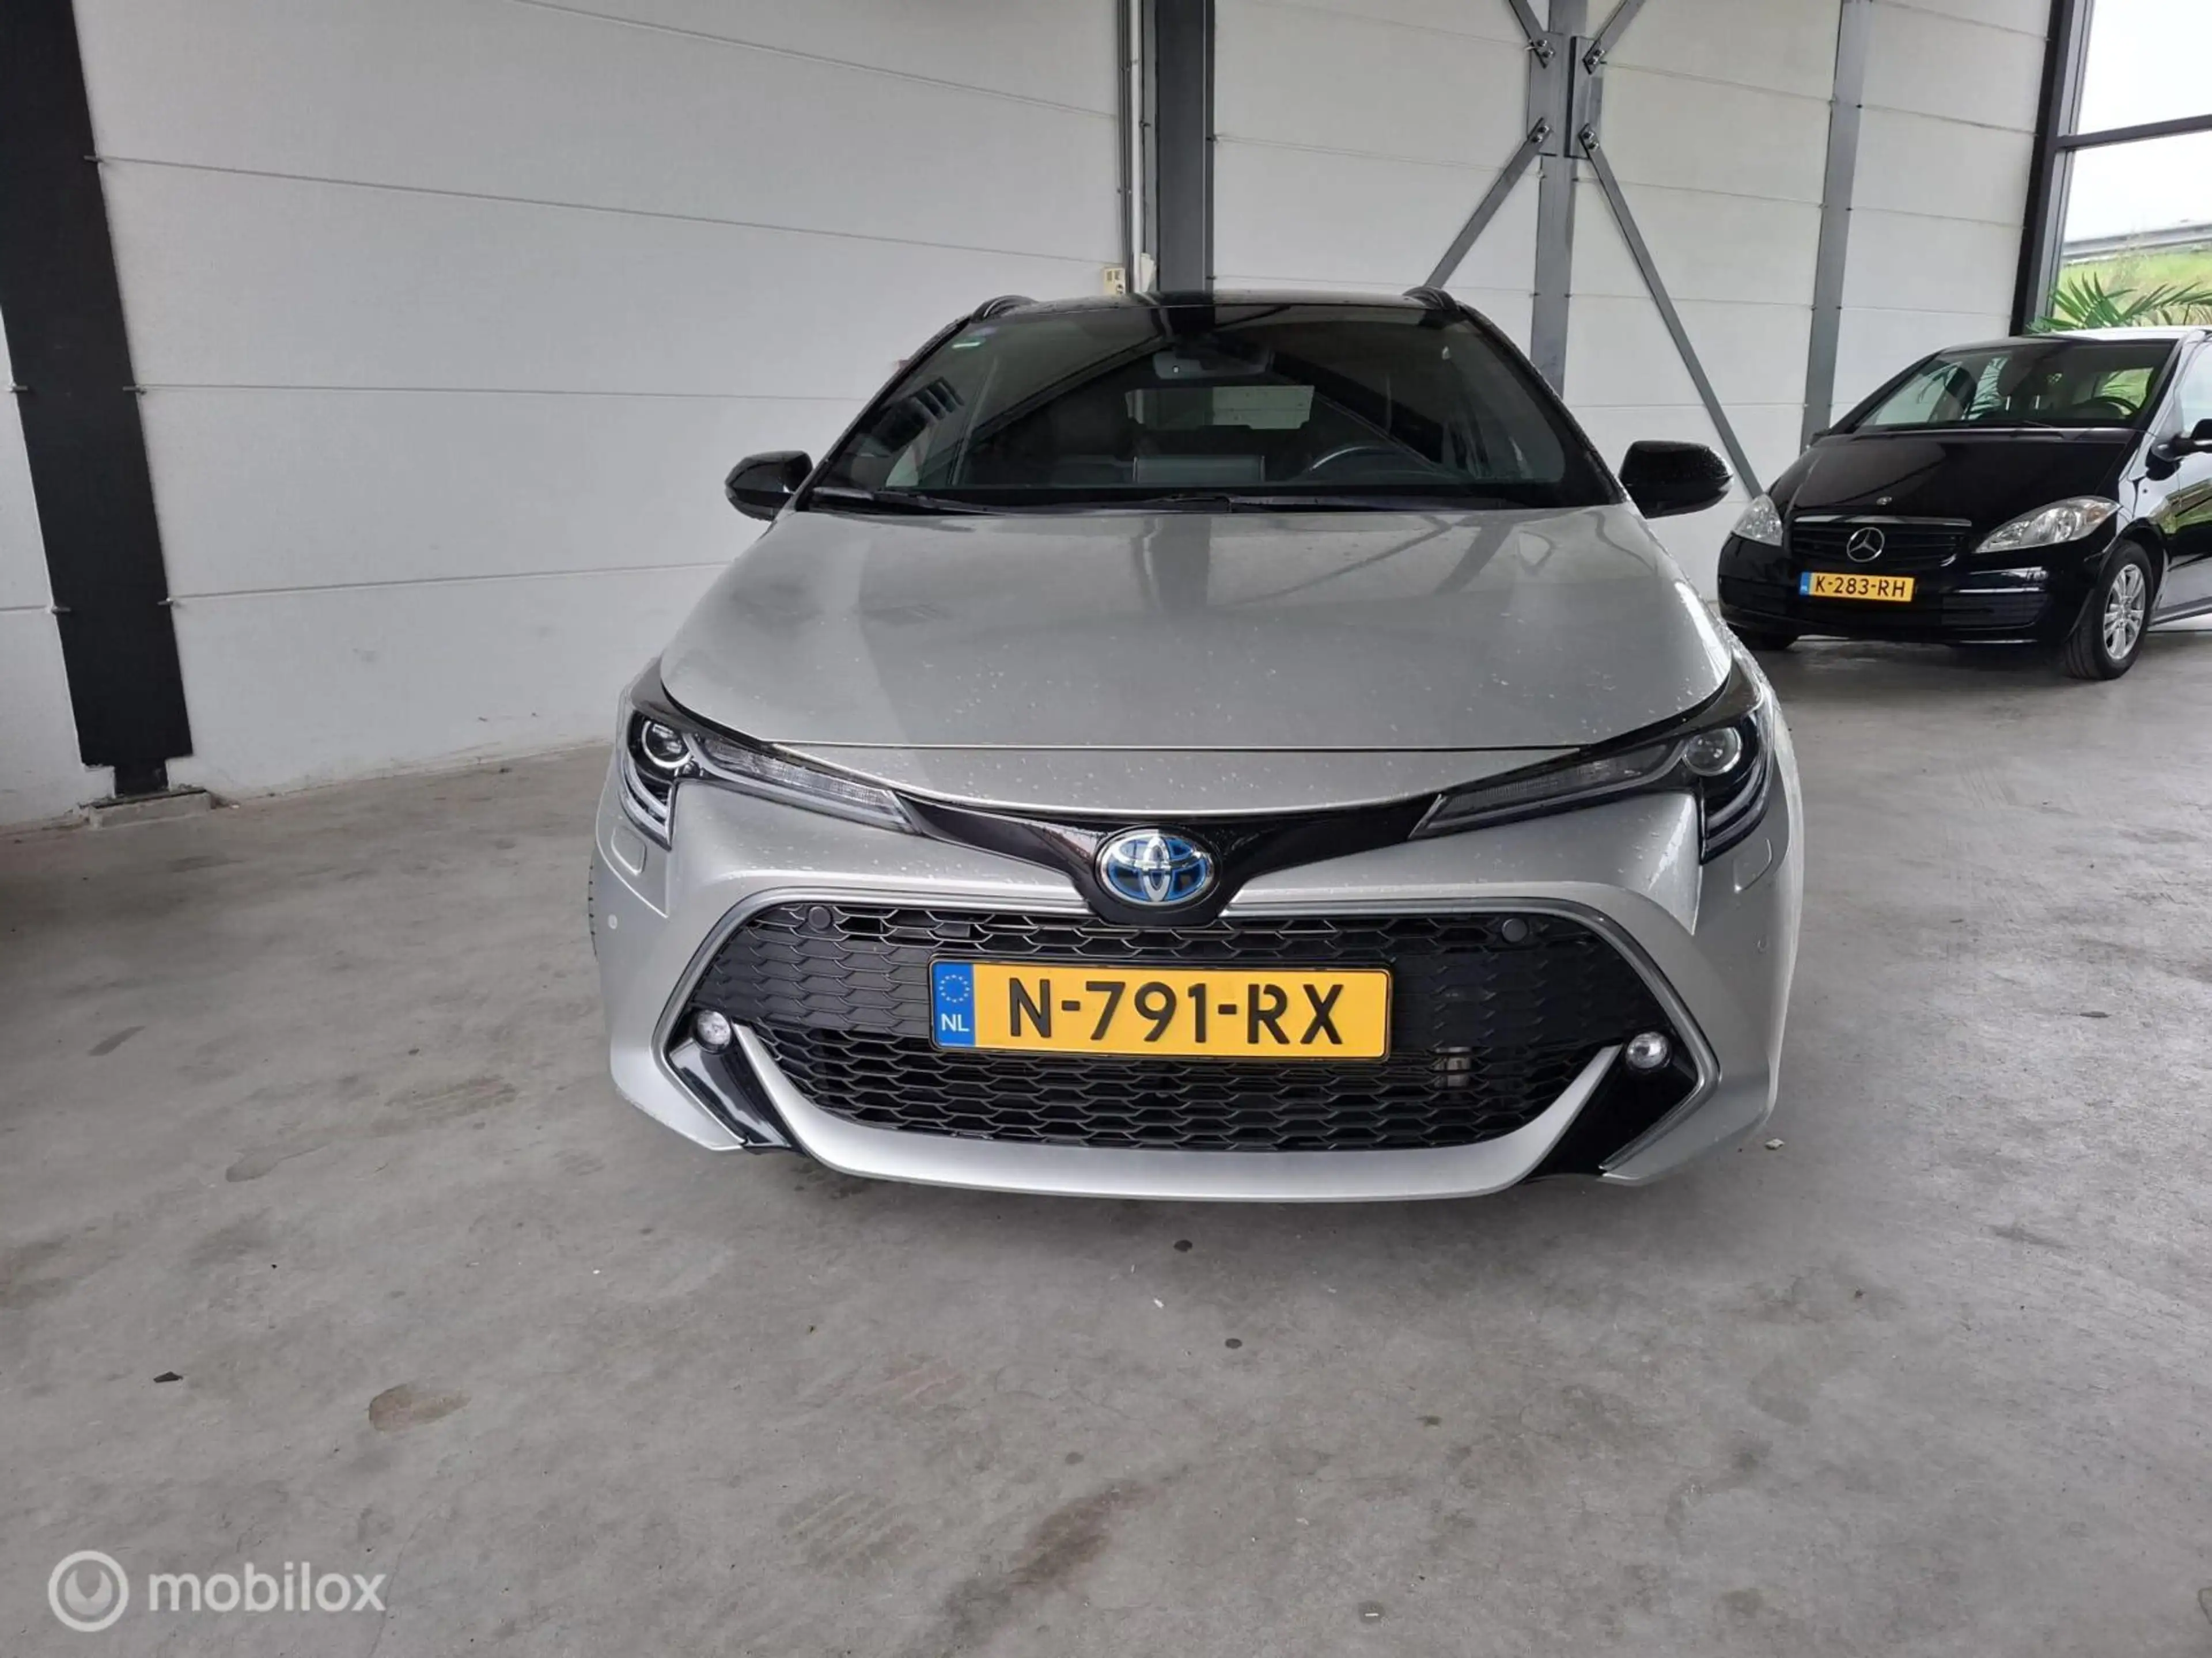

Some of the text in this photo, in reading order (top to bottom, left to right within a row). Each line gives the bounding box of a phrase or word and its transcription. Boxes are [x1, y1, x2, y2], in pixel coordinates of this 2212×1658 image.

[1815, 576, 1906, 597] K-283-RH
[1009, 977, 1344, 1045] N-791-RX
[941, 1013, 969, 1033] NL
